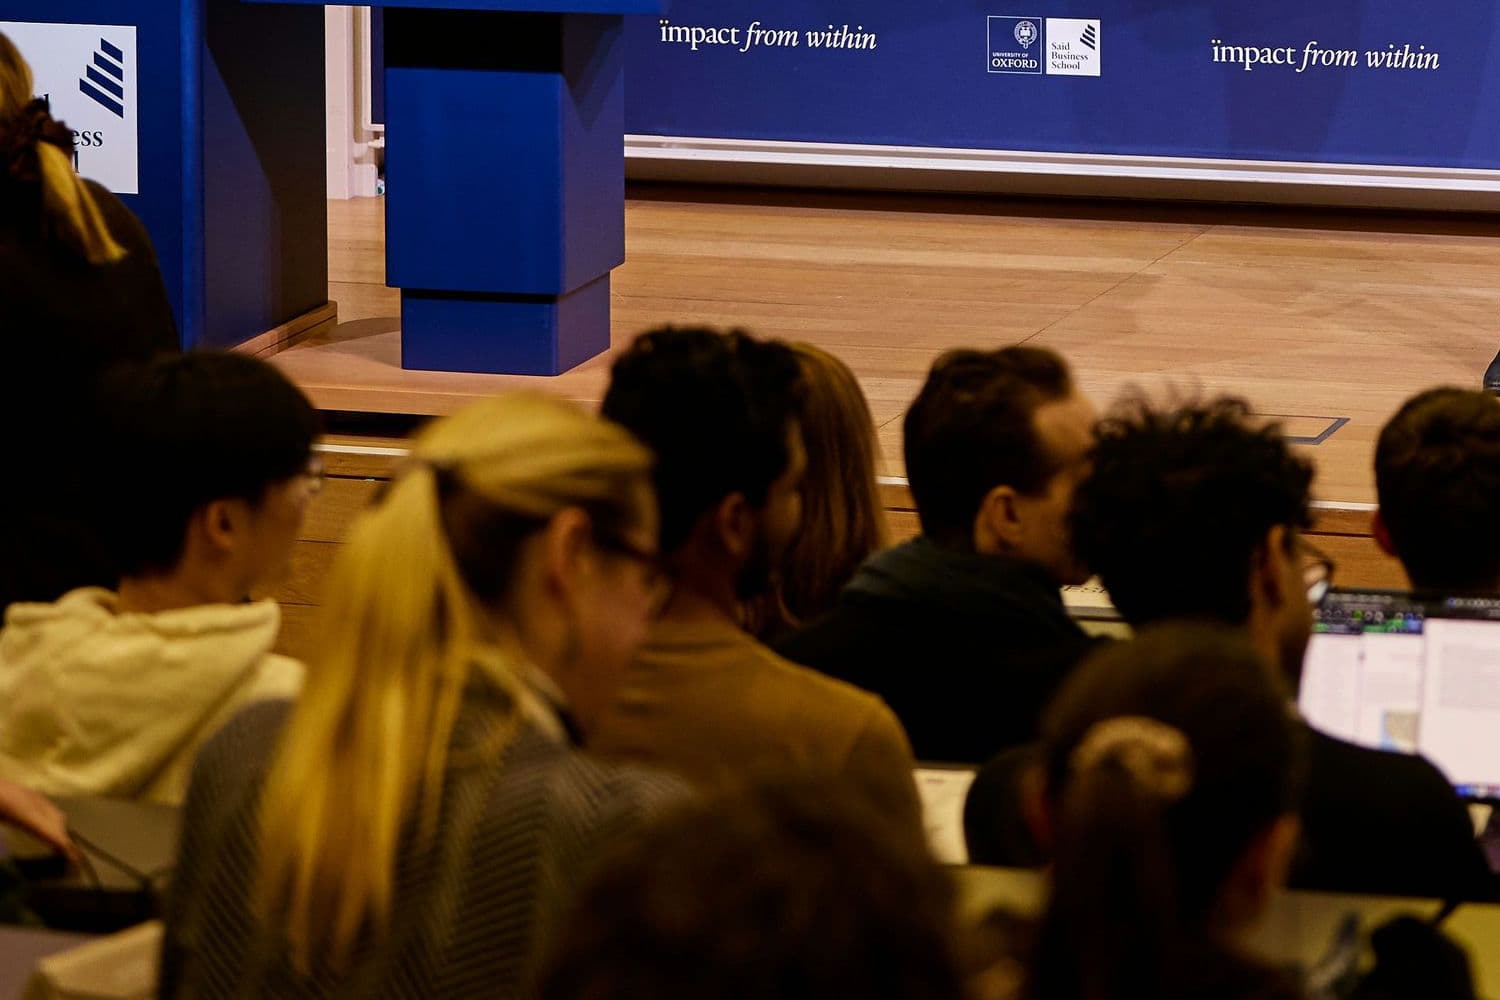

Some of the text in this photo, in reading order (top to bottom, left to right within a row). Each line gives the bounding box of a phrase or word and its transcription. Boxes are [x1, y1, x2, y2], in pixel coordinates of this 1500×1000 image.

[739, 22, 799, 52] from
[806, 25, 877, 49] within
[1052, 52, 1088, 60] Business
[1296, 41, 1358, 72] from
[1365, 45, 1439, 69] within
[992, 59, 1037, 68] OXFORD
[1052, 61, 1080, 70] School
